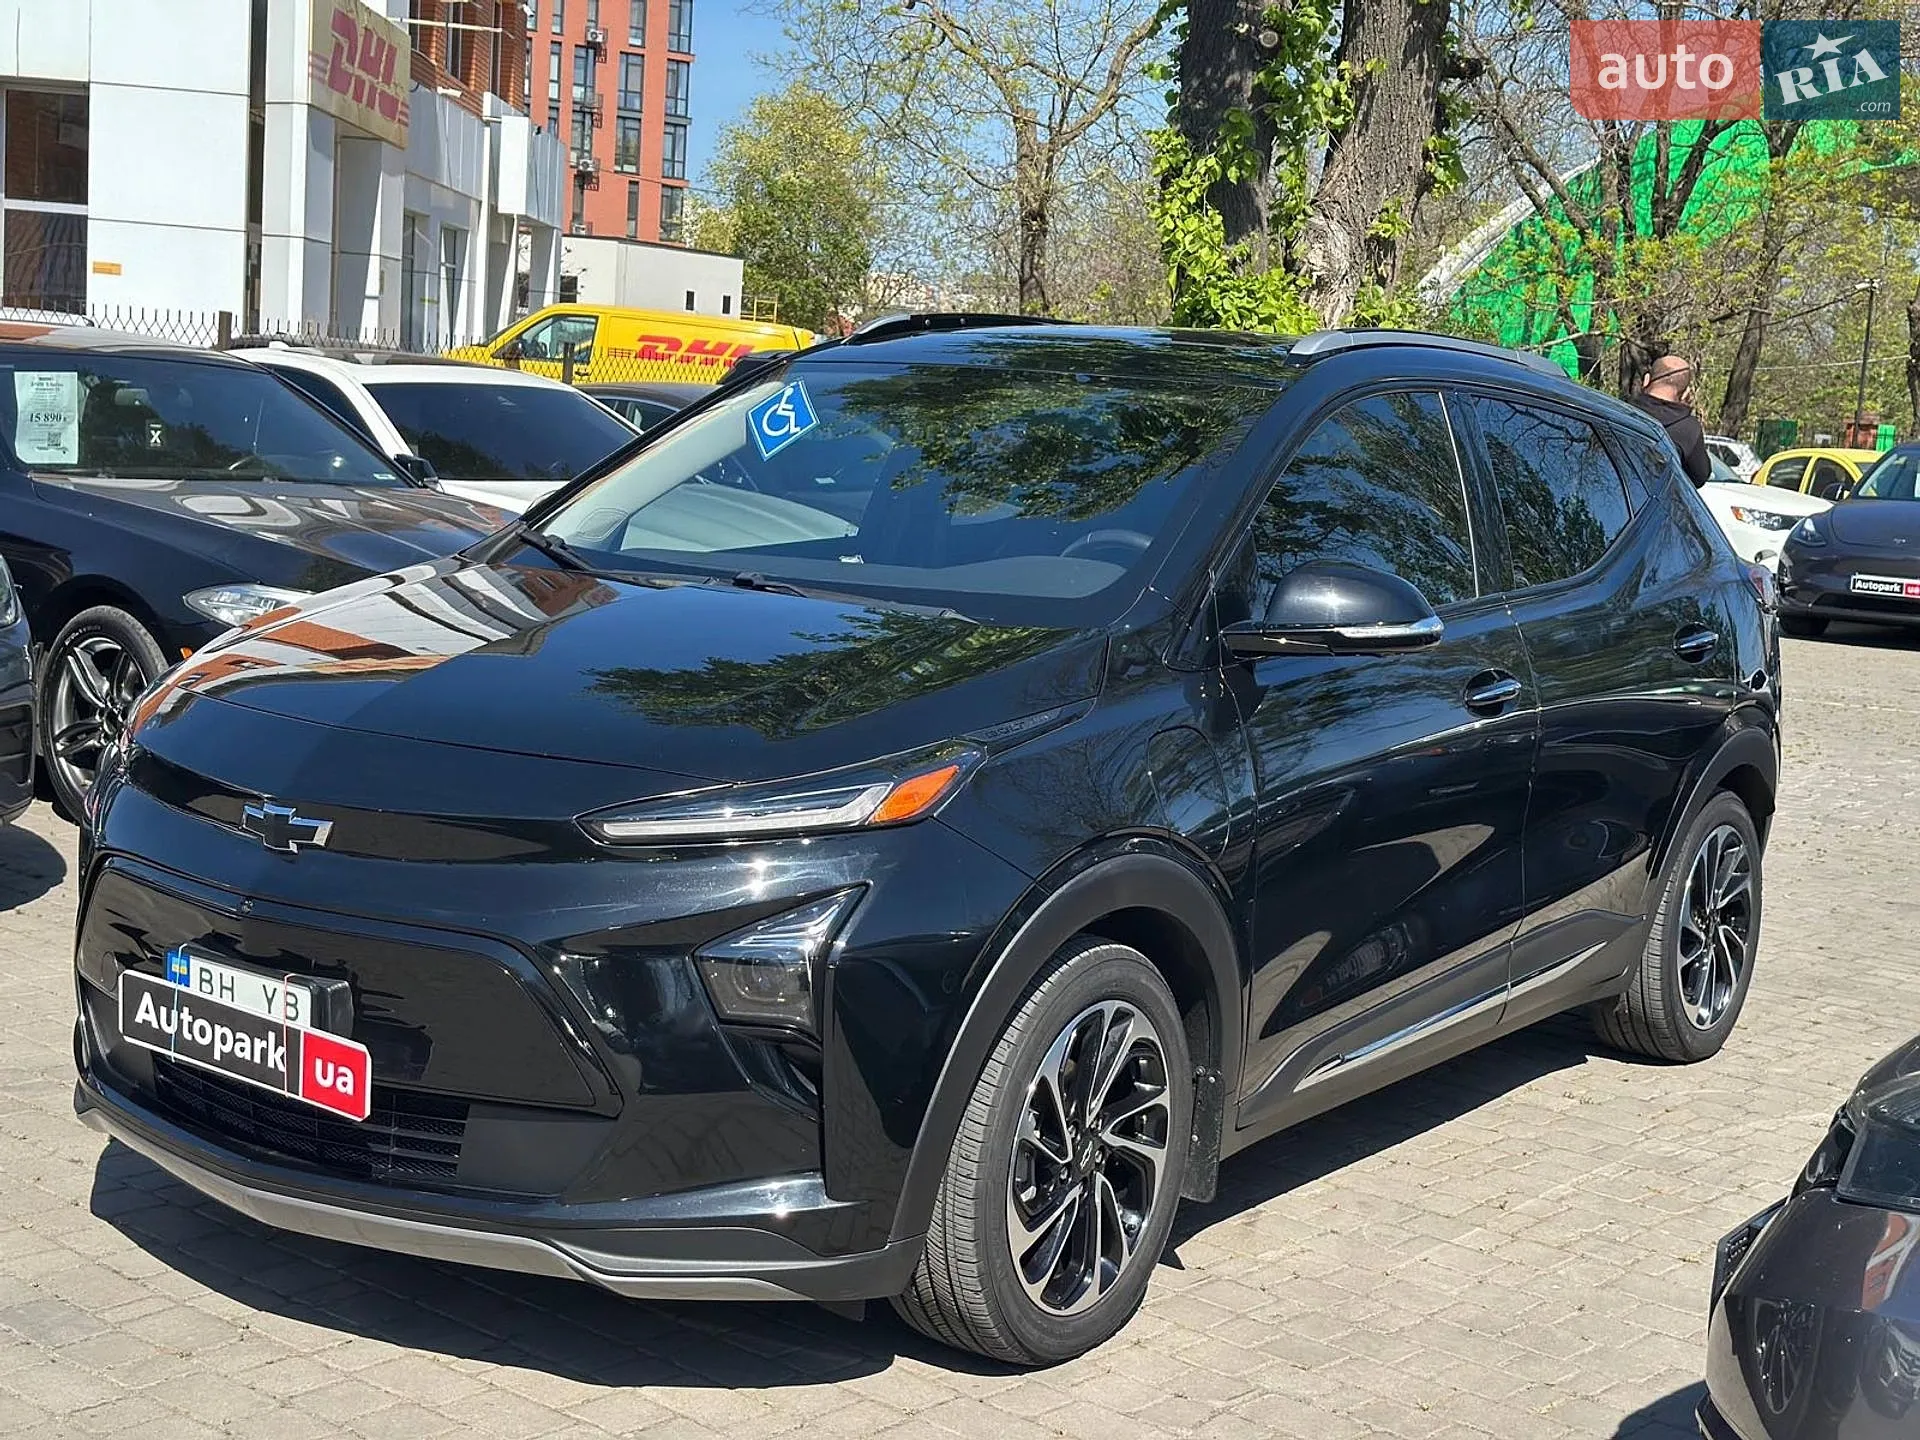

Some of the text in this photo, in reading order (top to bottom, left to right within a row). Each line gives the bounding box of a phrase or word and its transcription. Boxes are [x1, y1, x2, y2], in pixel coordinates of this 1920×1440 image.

[327, 7, 402, 121] DHL
[635, 335, 755, 367] DHL
[1856, 580, 1901, 592] Autopark
[199, 967, 299, 1022] BH YB
[134, 991, 354, 1096] Autopark ua
